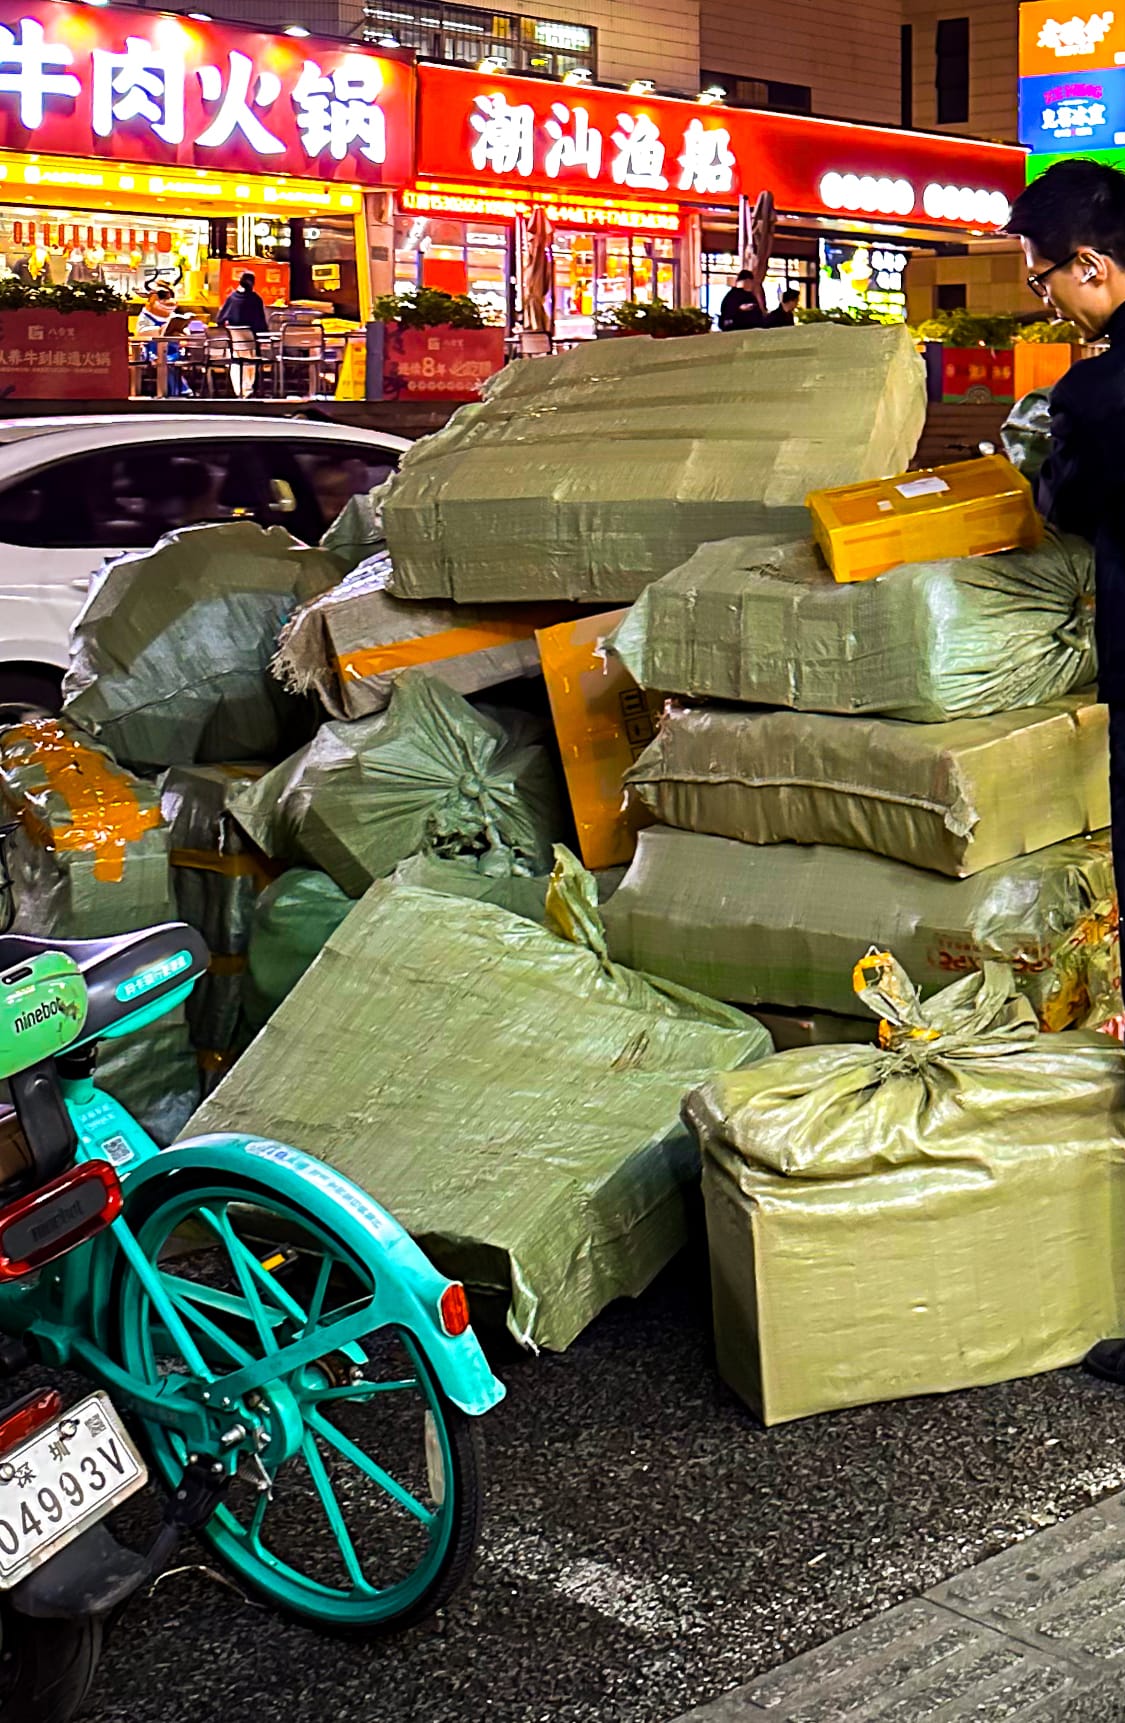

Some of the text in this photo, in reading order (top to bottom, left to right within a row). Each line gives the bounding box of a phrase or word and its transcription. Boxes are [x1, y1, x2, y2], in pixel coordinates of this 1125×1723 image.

[0, 17, 386, 164] 牛肉火锅
[470, 92, 736, 193] 潮汕渔船
